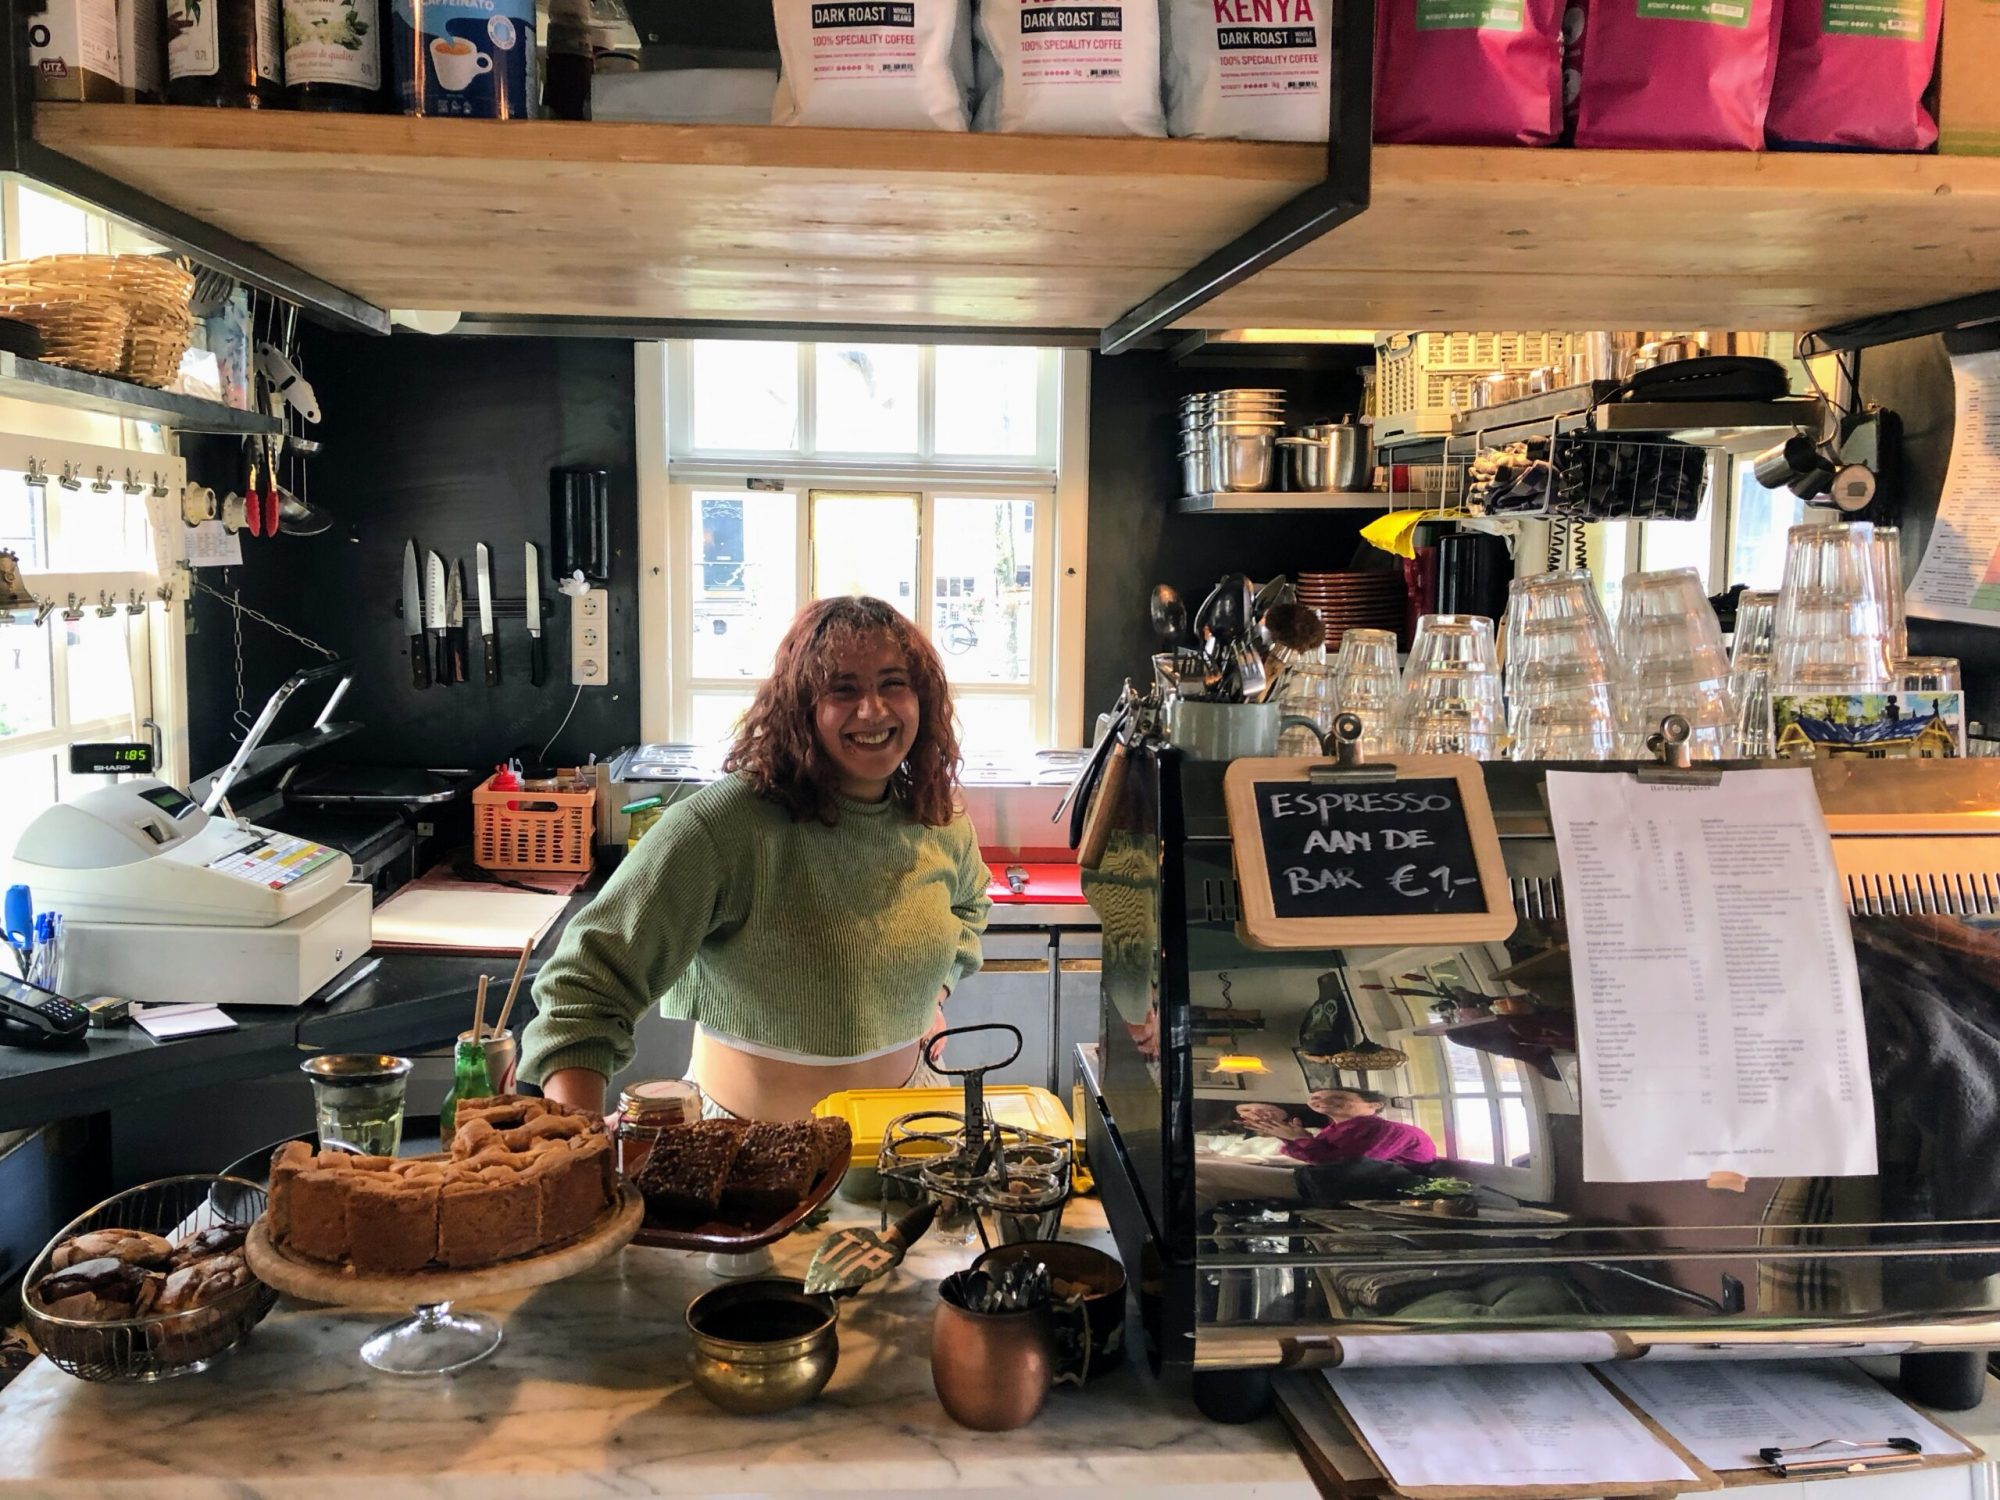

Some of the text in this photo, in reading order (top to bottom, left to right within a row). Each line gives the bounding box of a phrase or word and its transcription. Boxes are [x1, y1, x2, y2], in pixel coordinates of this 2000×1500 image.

[814, 7, 886, 24] DARK ROAST
[1212, 0, 1314, 23] KENYA
[1023, 12, 1094, 28] DARK ROAST
[812, 34, 915, 47] 100% SPECIALITY COFFEE
[1021, 39, 1122, 51] 100% SPECIALITY COFFEE
[1220, 31, 1288, 45] DARK ROAST
[43, 62, 62, 71] UTZ
[1220, 54, 1319, 66] 100% SPECIALITY COFFEE
[1270, 792, 1451, 826] ESPRESSO
[1303, 829, 1436, 854] AAN DE
[1283, 866, 1364, 896] BAR
